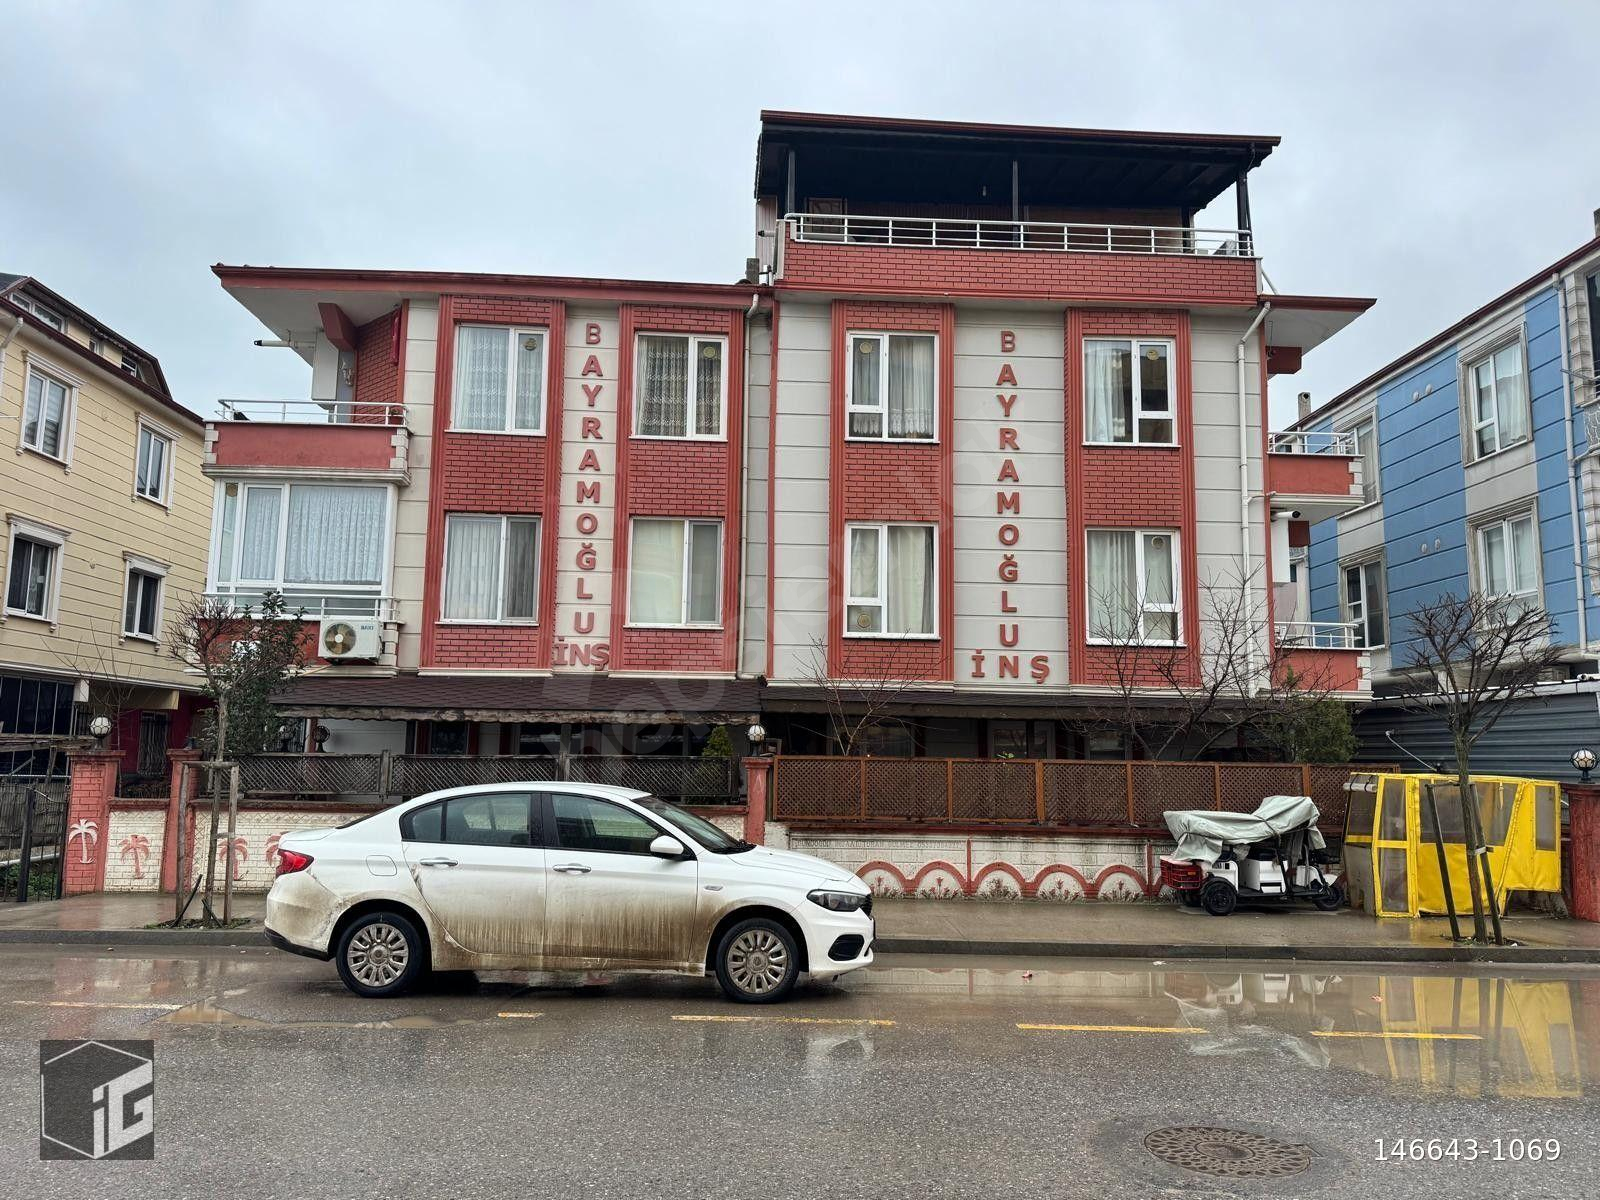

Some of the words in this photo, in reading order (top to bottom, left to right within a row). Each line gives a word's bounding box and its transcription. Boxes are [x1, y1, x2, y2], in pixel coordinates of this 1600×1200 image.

[575, 322, 603, 634] BAYRAMOĞLU
[996, 330, 1020, 648] BAYRAMOĞLU
[553, 636, 610, 672] İNŞ
[971, 649, 1051, 685] İNŞ
